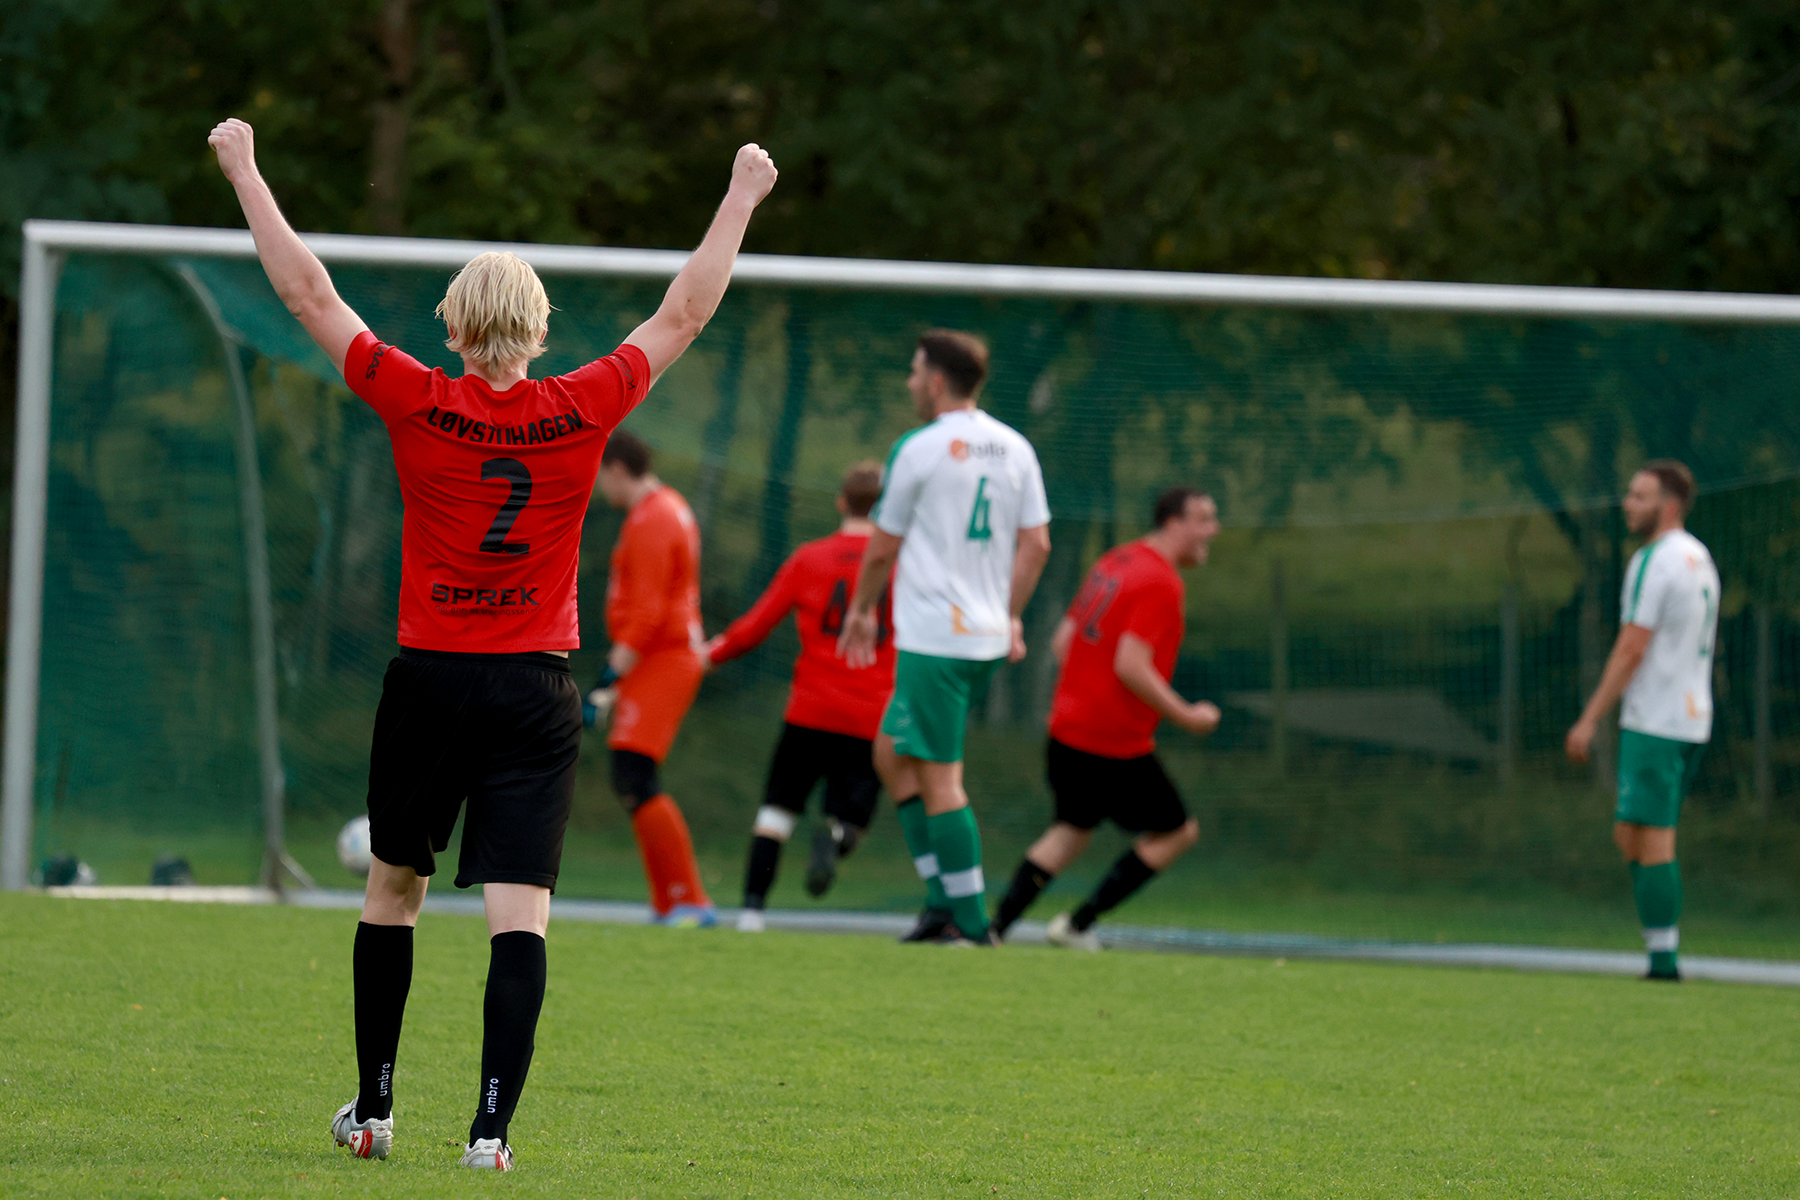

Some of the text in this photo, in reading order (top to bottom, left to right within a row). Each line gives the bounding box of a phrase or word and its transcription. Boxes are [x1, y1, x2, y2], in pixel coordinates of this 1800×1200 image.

[427, 406, 583, 445] LØVSTIHAGEN
[479, 457, 533, 555] 2
[431, 583, 540, 606] SPREK
[378, 1063, 391, 1097] umbro
[486, 1077, 499, 1114] umbro
